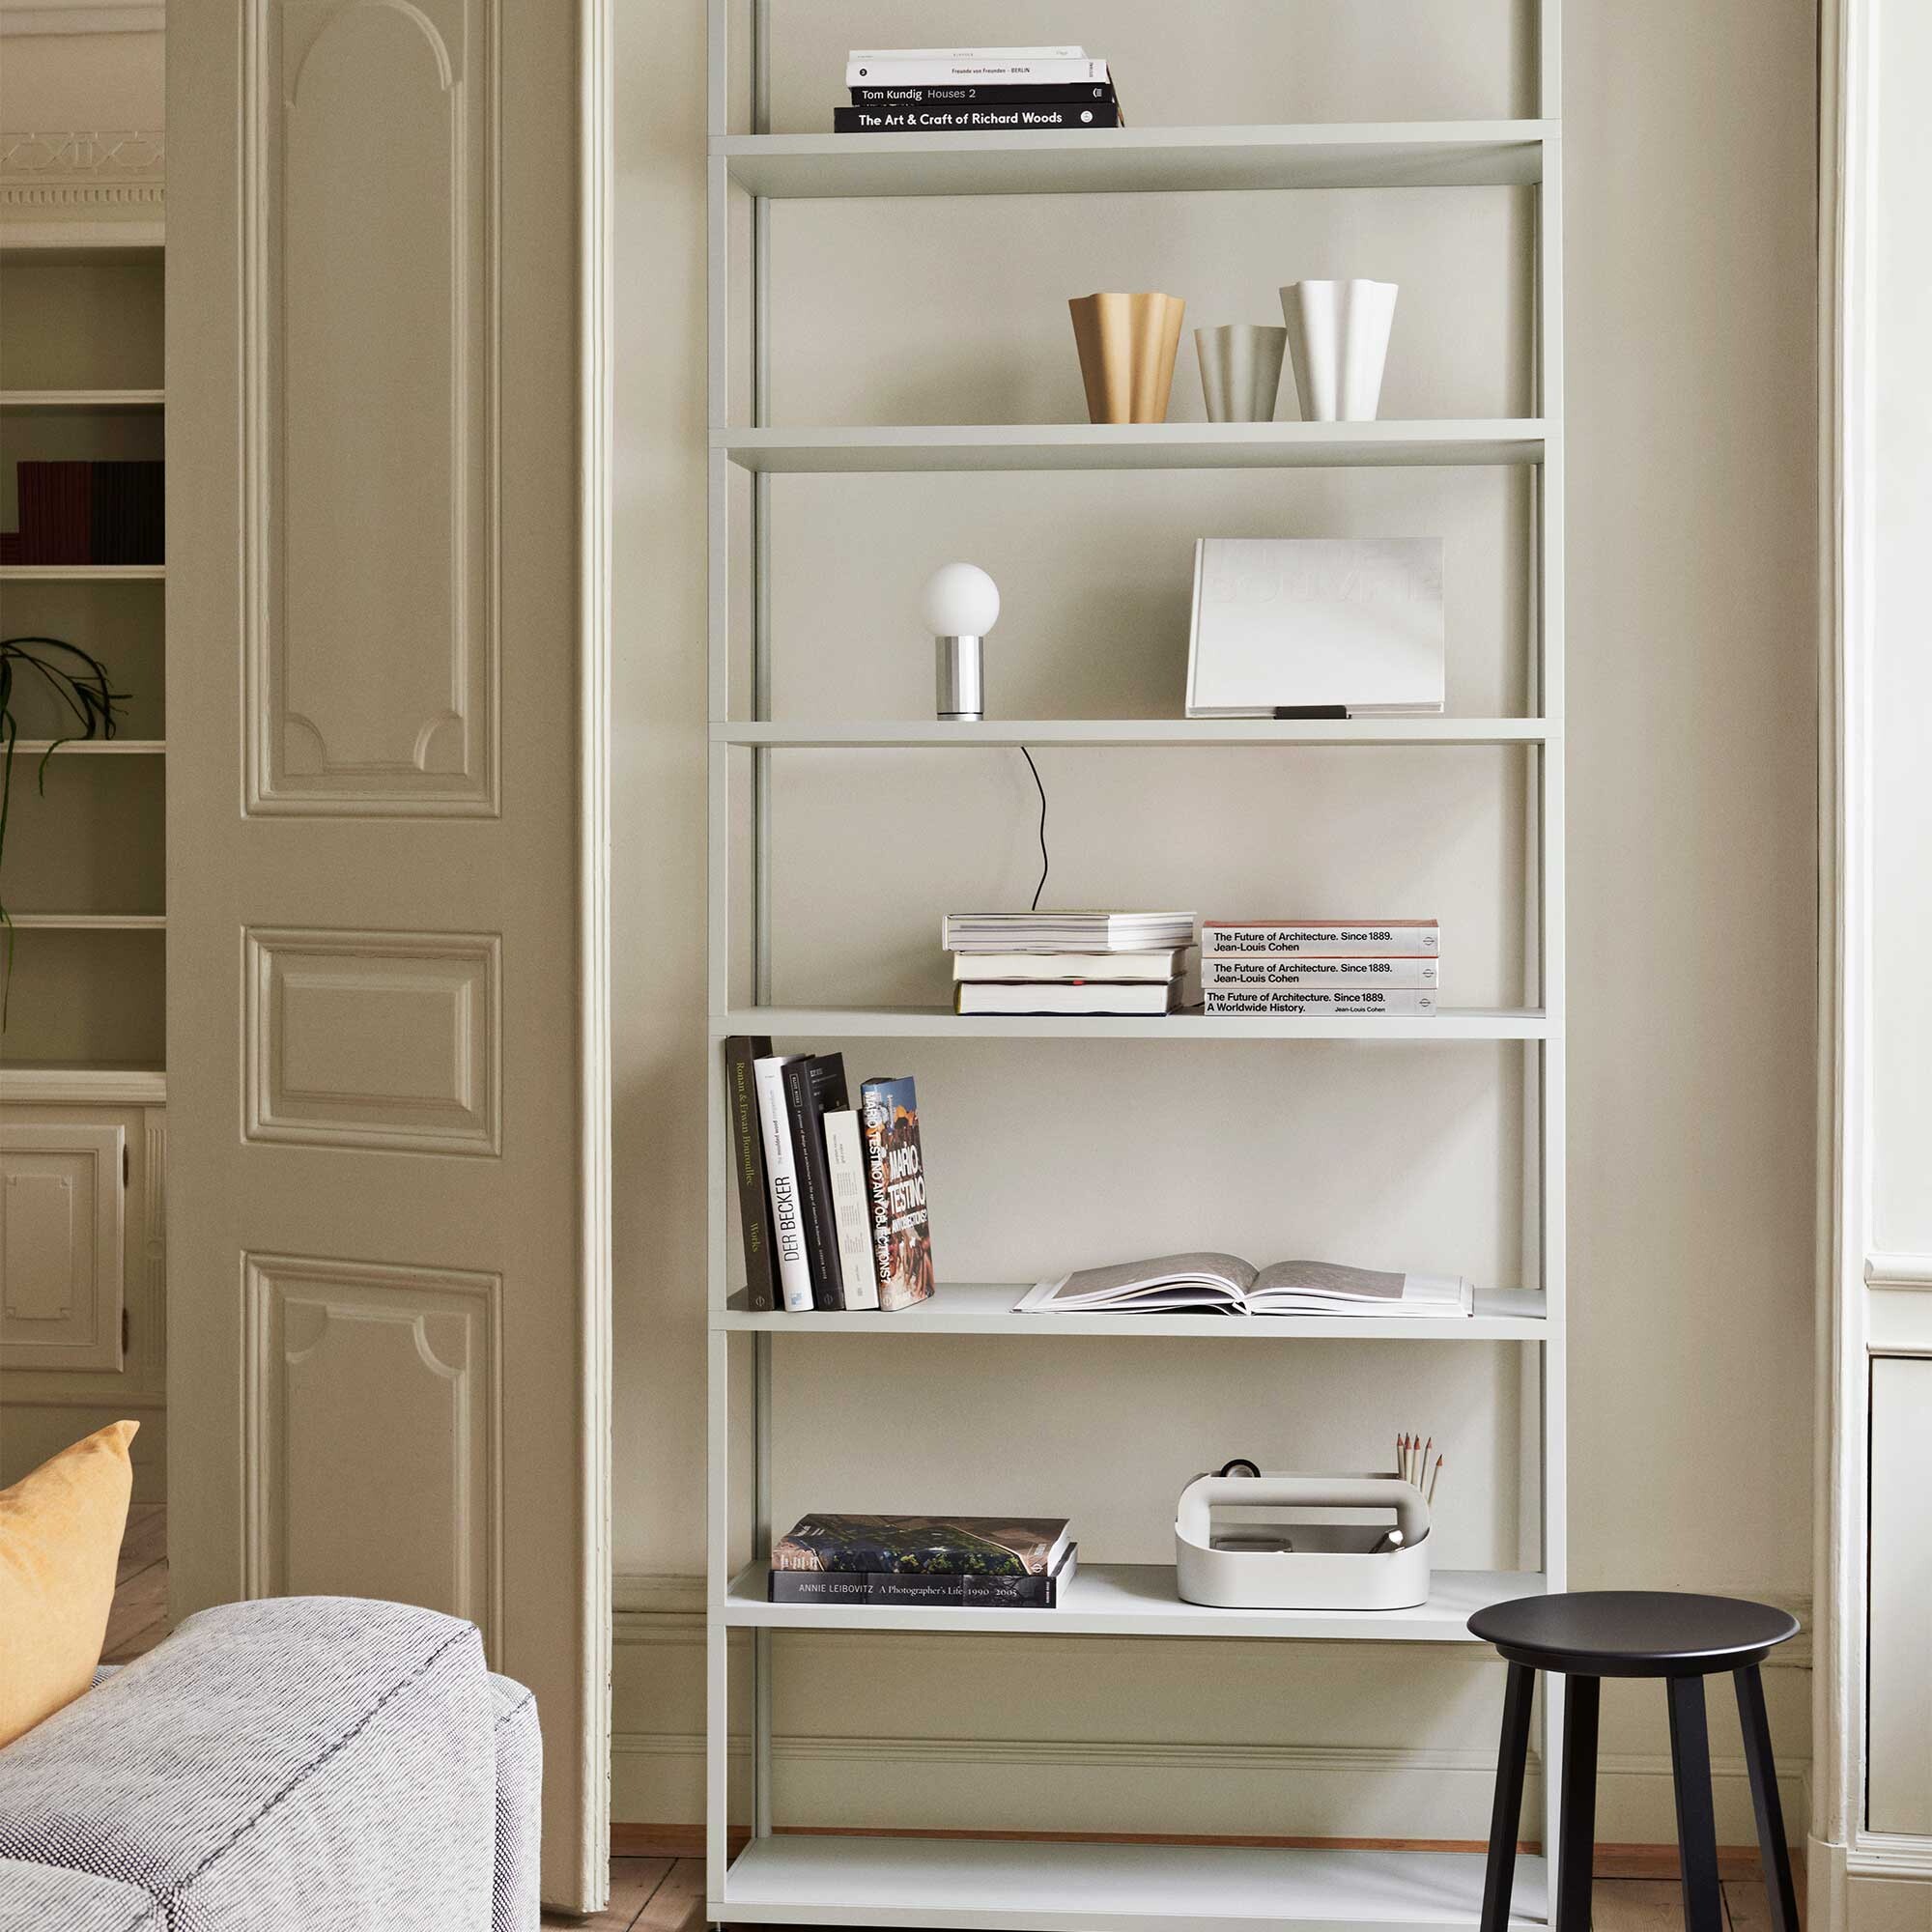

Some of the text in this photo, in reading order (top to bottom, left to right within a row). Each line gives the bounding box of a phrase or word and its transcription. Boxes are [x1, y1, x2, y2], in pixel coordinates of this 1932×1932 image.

[862, 89, 976, 101] Tom Kundig Houses 2
[859, 111, 1063, 126] The Art & Craft of Richard Woods
[1213, 932, 1393, 942] The Future of Architecture. Since 1889.
[1213, 943, 1299, 952] Jean-Louis Cohen
[1213, 963, 1393, 973] The Future of Architecture. Since 1889.
[1213, 974, 1299, 982] Jean-Louis Cohen
[1207, 992, 1386, 1002] The Future of Architecture. Since 1889.
[1207, 1003, 1306, 1013] A Worldwide History.
[736, 1063, 745, 1092] Ronan
[740, 1103, 749, 1133] Erwan
[865, 1092, 879, 1129] MARIO
[743, 1136, 754, 1187] Bouroullec
[867, 1131, 884, 1180] TESTINO
[889, 1145, 919, 1182] MARIO
[872, 1181, 890, 1208] ANY
[887, 1176, 926, 1215] TESTINO
[775, 1176, 800, 1263] DER BECKER
[750, 1222, 761, 1253] Works
[798, 1583, 874, 1594] ANNIE LEIBOVITZ
[880, 1585, 887, 1594] A
[888, 1585, 946, 1596] Photographer's
[948, 1587, 962, 1596] Life
[996, 1589, 1018, 1598] 2005
